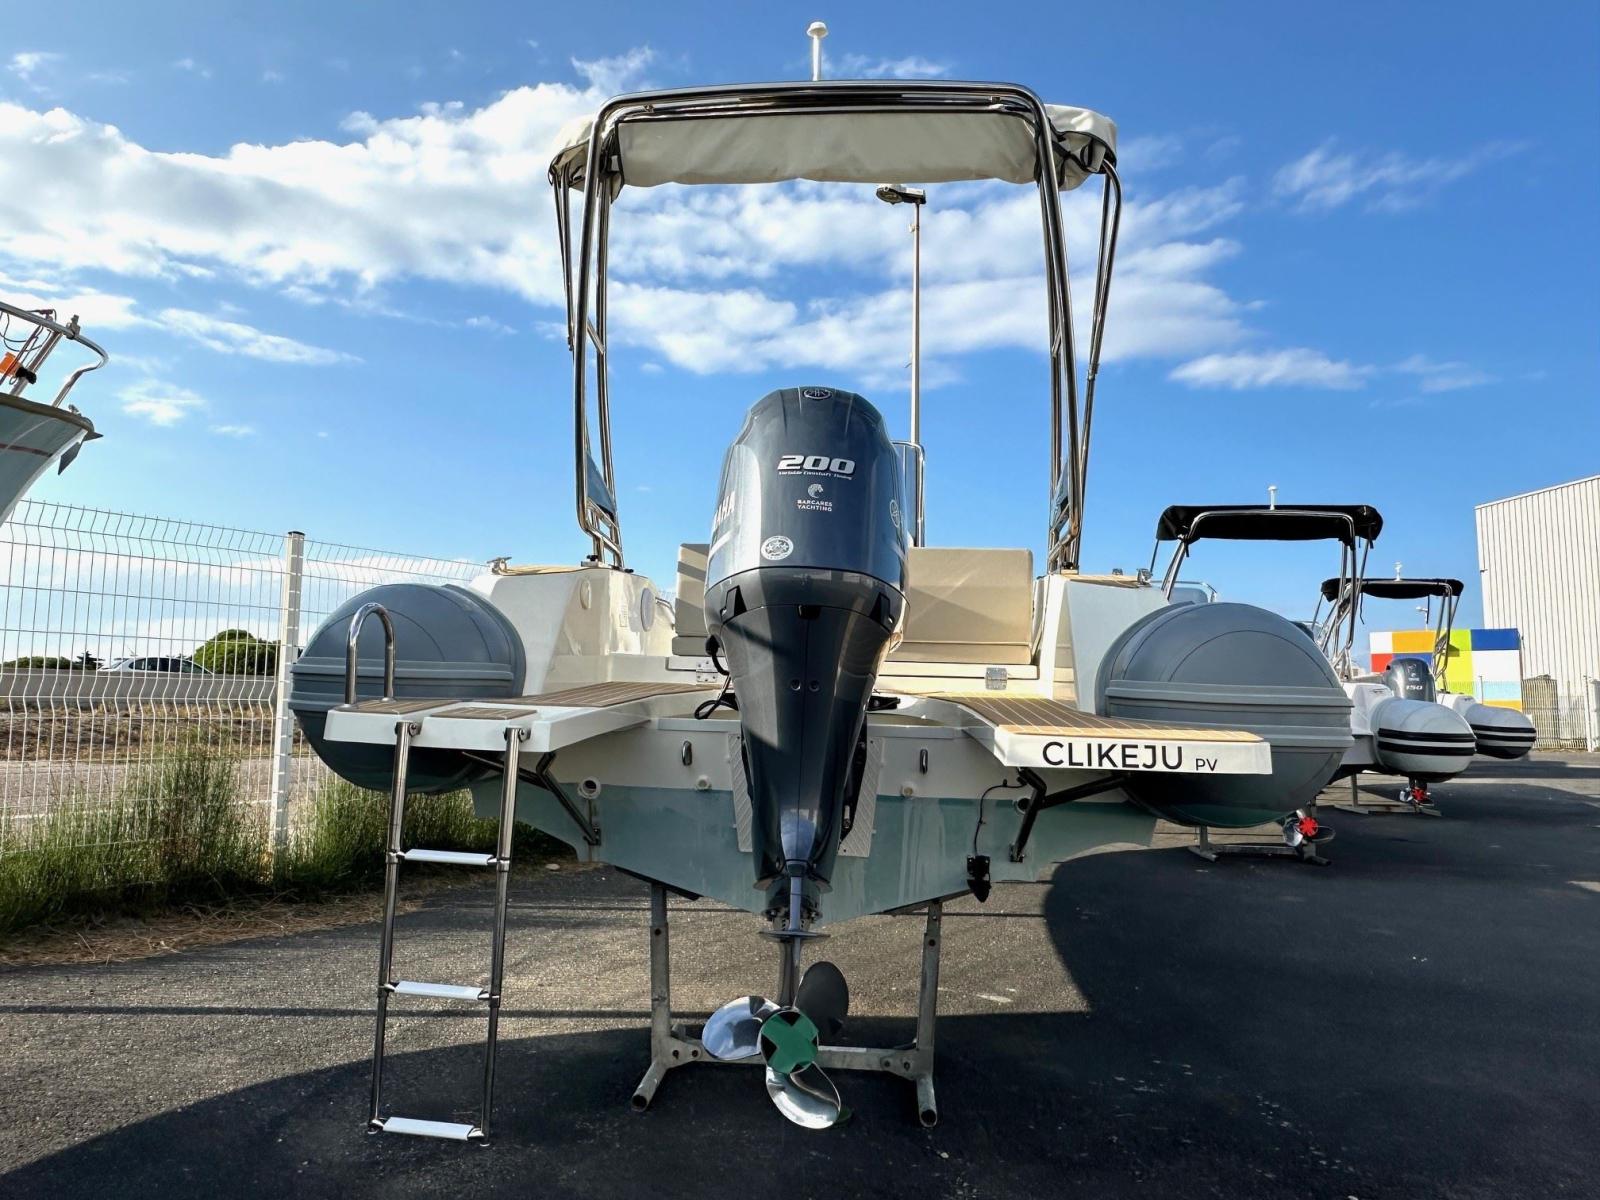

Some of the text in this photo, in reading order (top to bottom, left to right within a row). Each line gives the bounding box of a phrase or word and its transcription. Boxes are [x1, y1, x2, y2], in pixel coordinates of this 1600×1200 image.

[777, 455, 855, 474] 200
[797, 499, 832, 507] BARCARES
[797, 504, 832, 512] YACHTING
[1042, 741, 1218, 771] CLIKEJU PV
